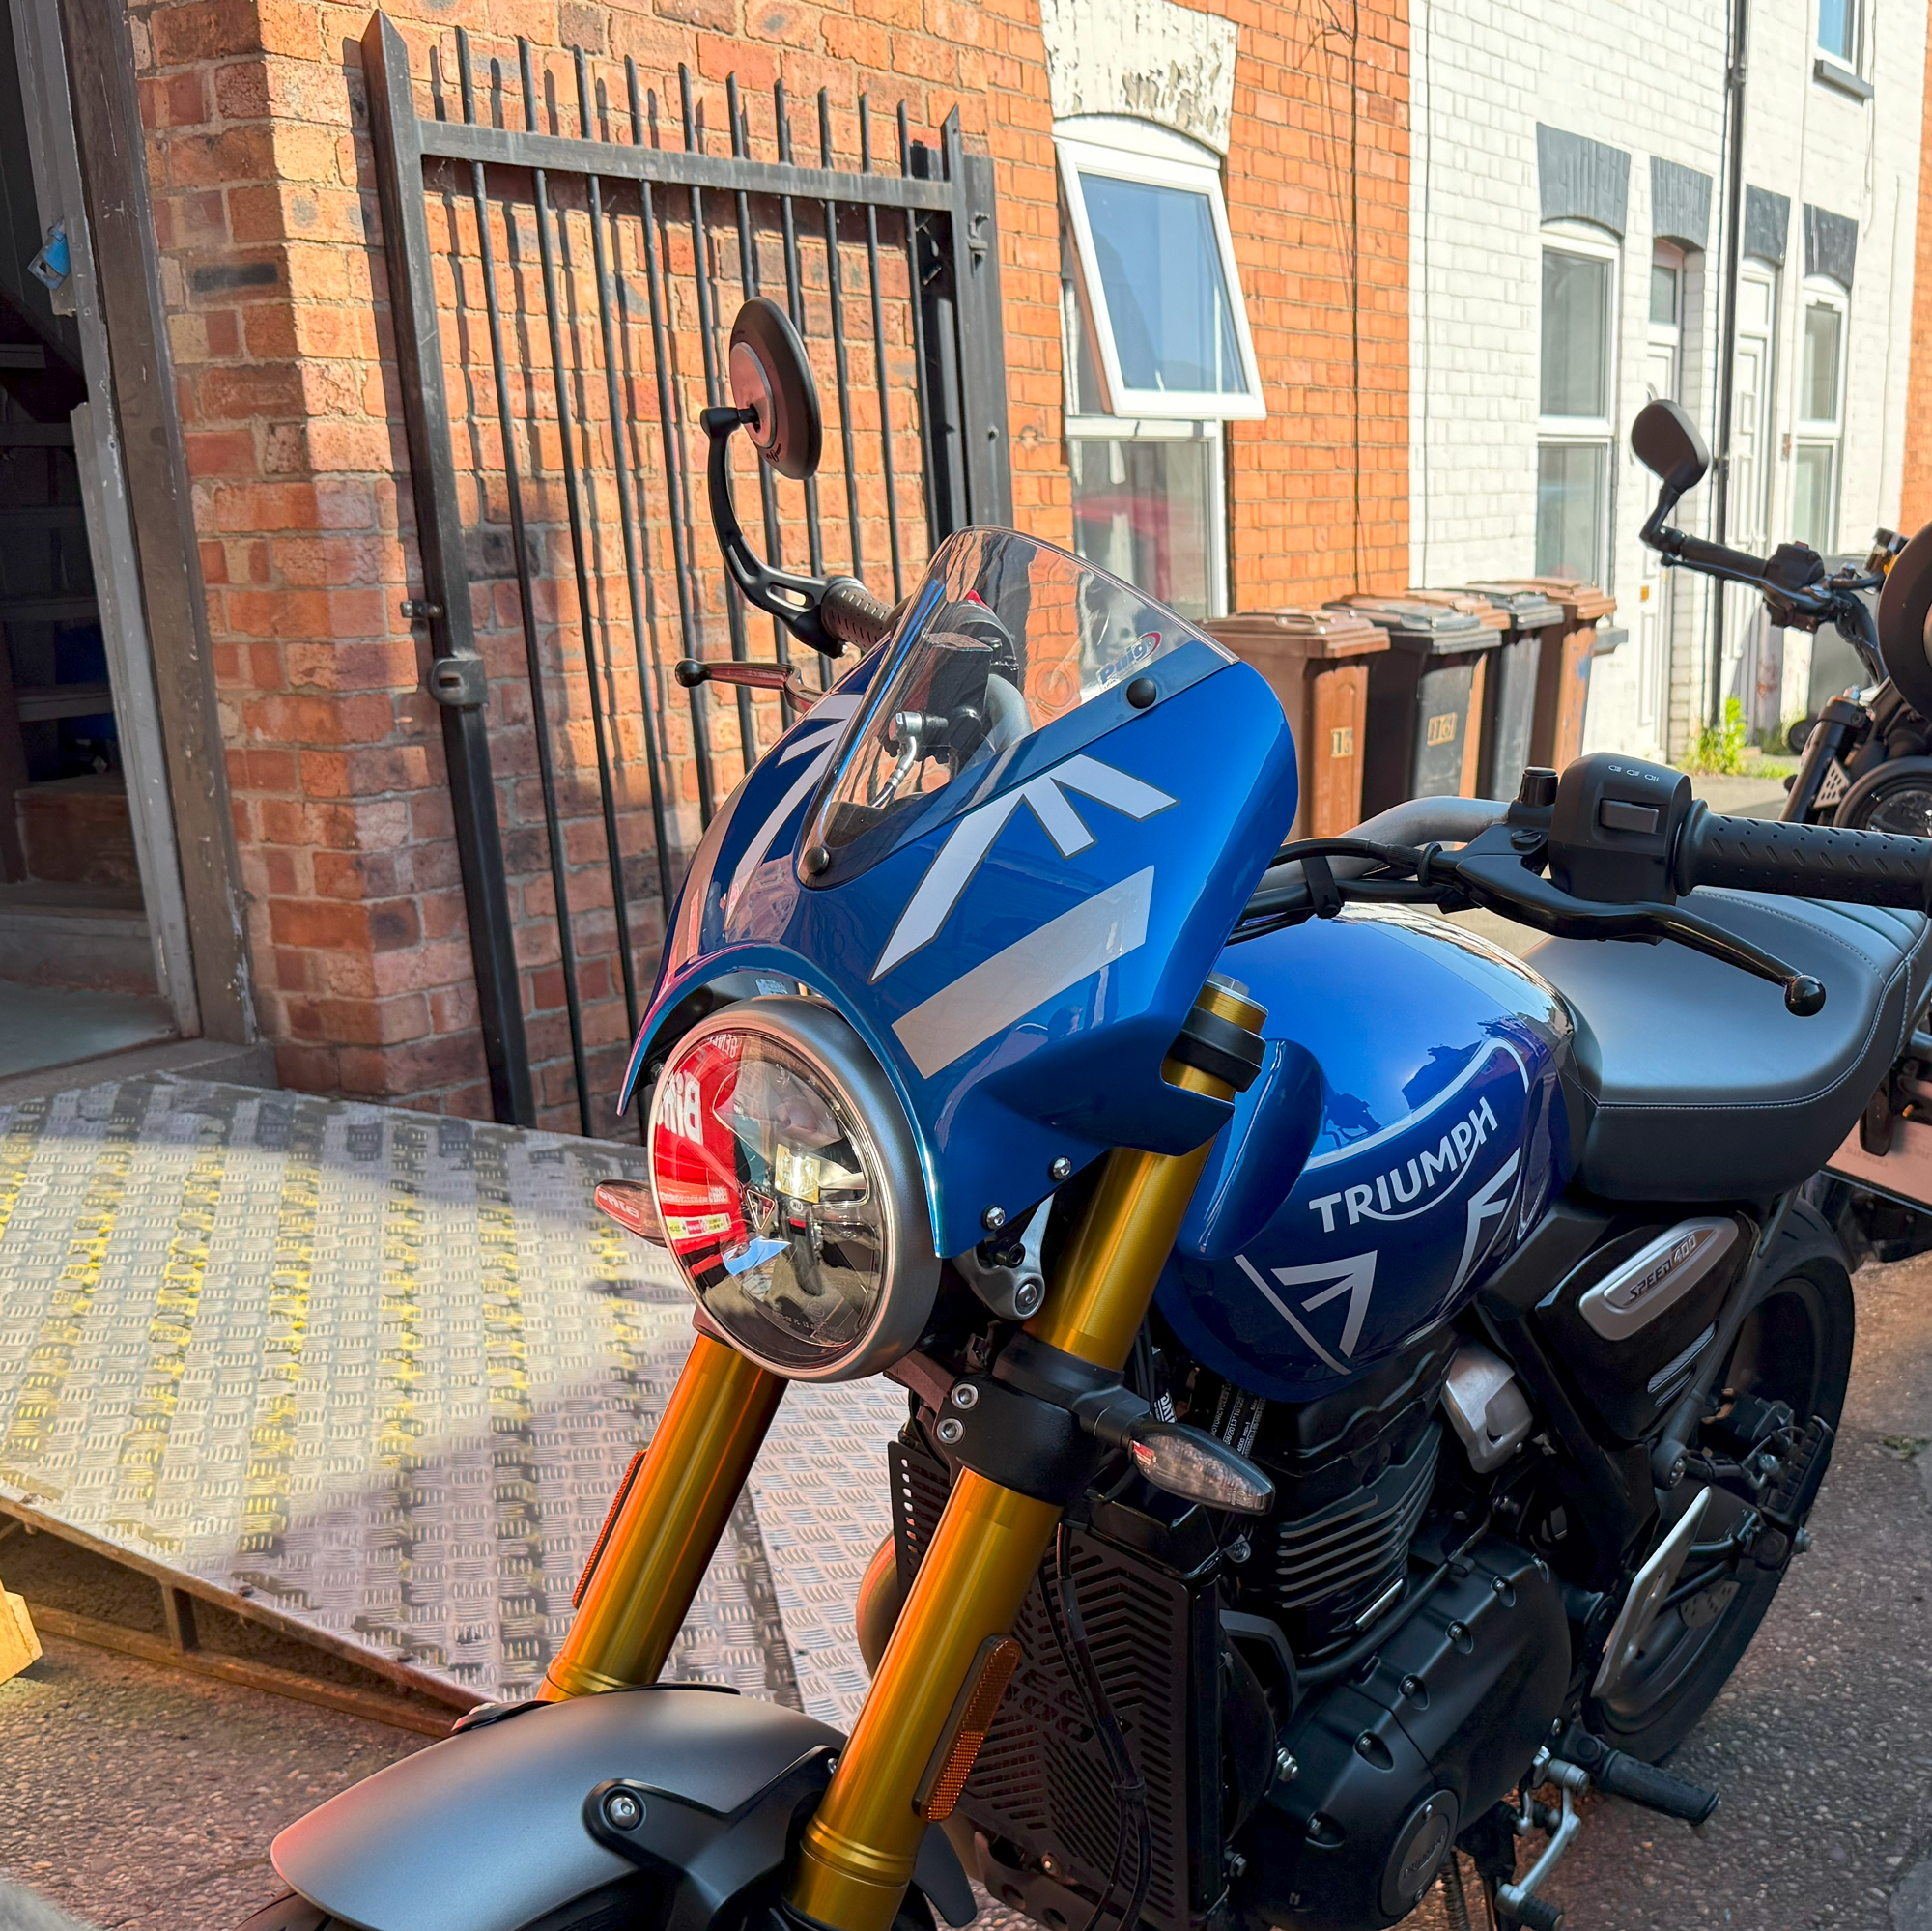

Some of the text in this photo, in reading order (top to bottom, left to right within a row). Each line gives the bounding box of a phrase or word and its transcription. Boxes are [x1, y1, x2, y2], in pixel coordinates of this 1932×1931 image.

[1309, 1096, 1498, 1233] TRIUMPH
[1630, 1235, 1697, 1299] SPEED 400
